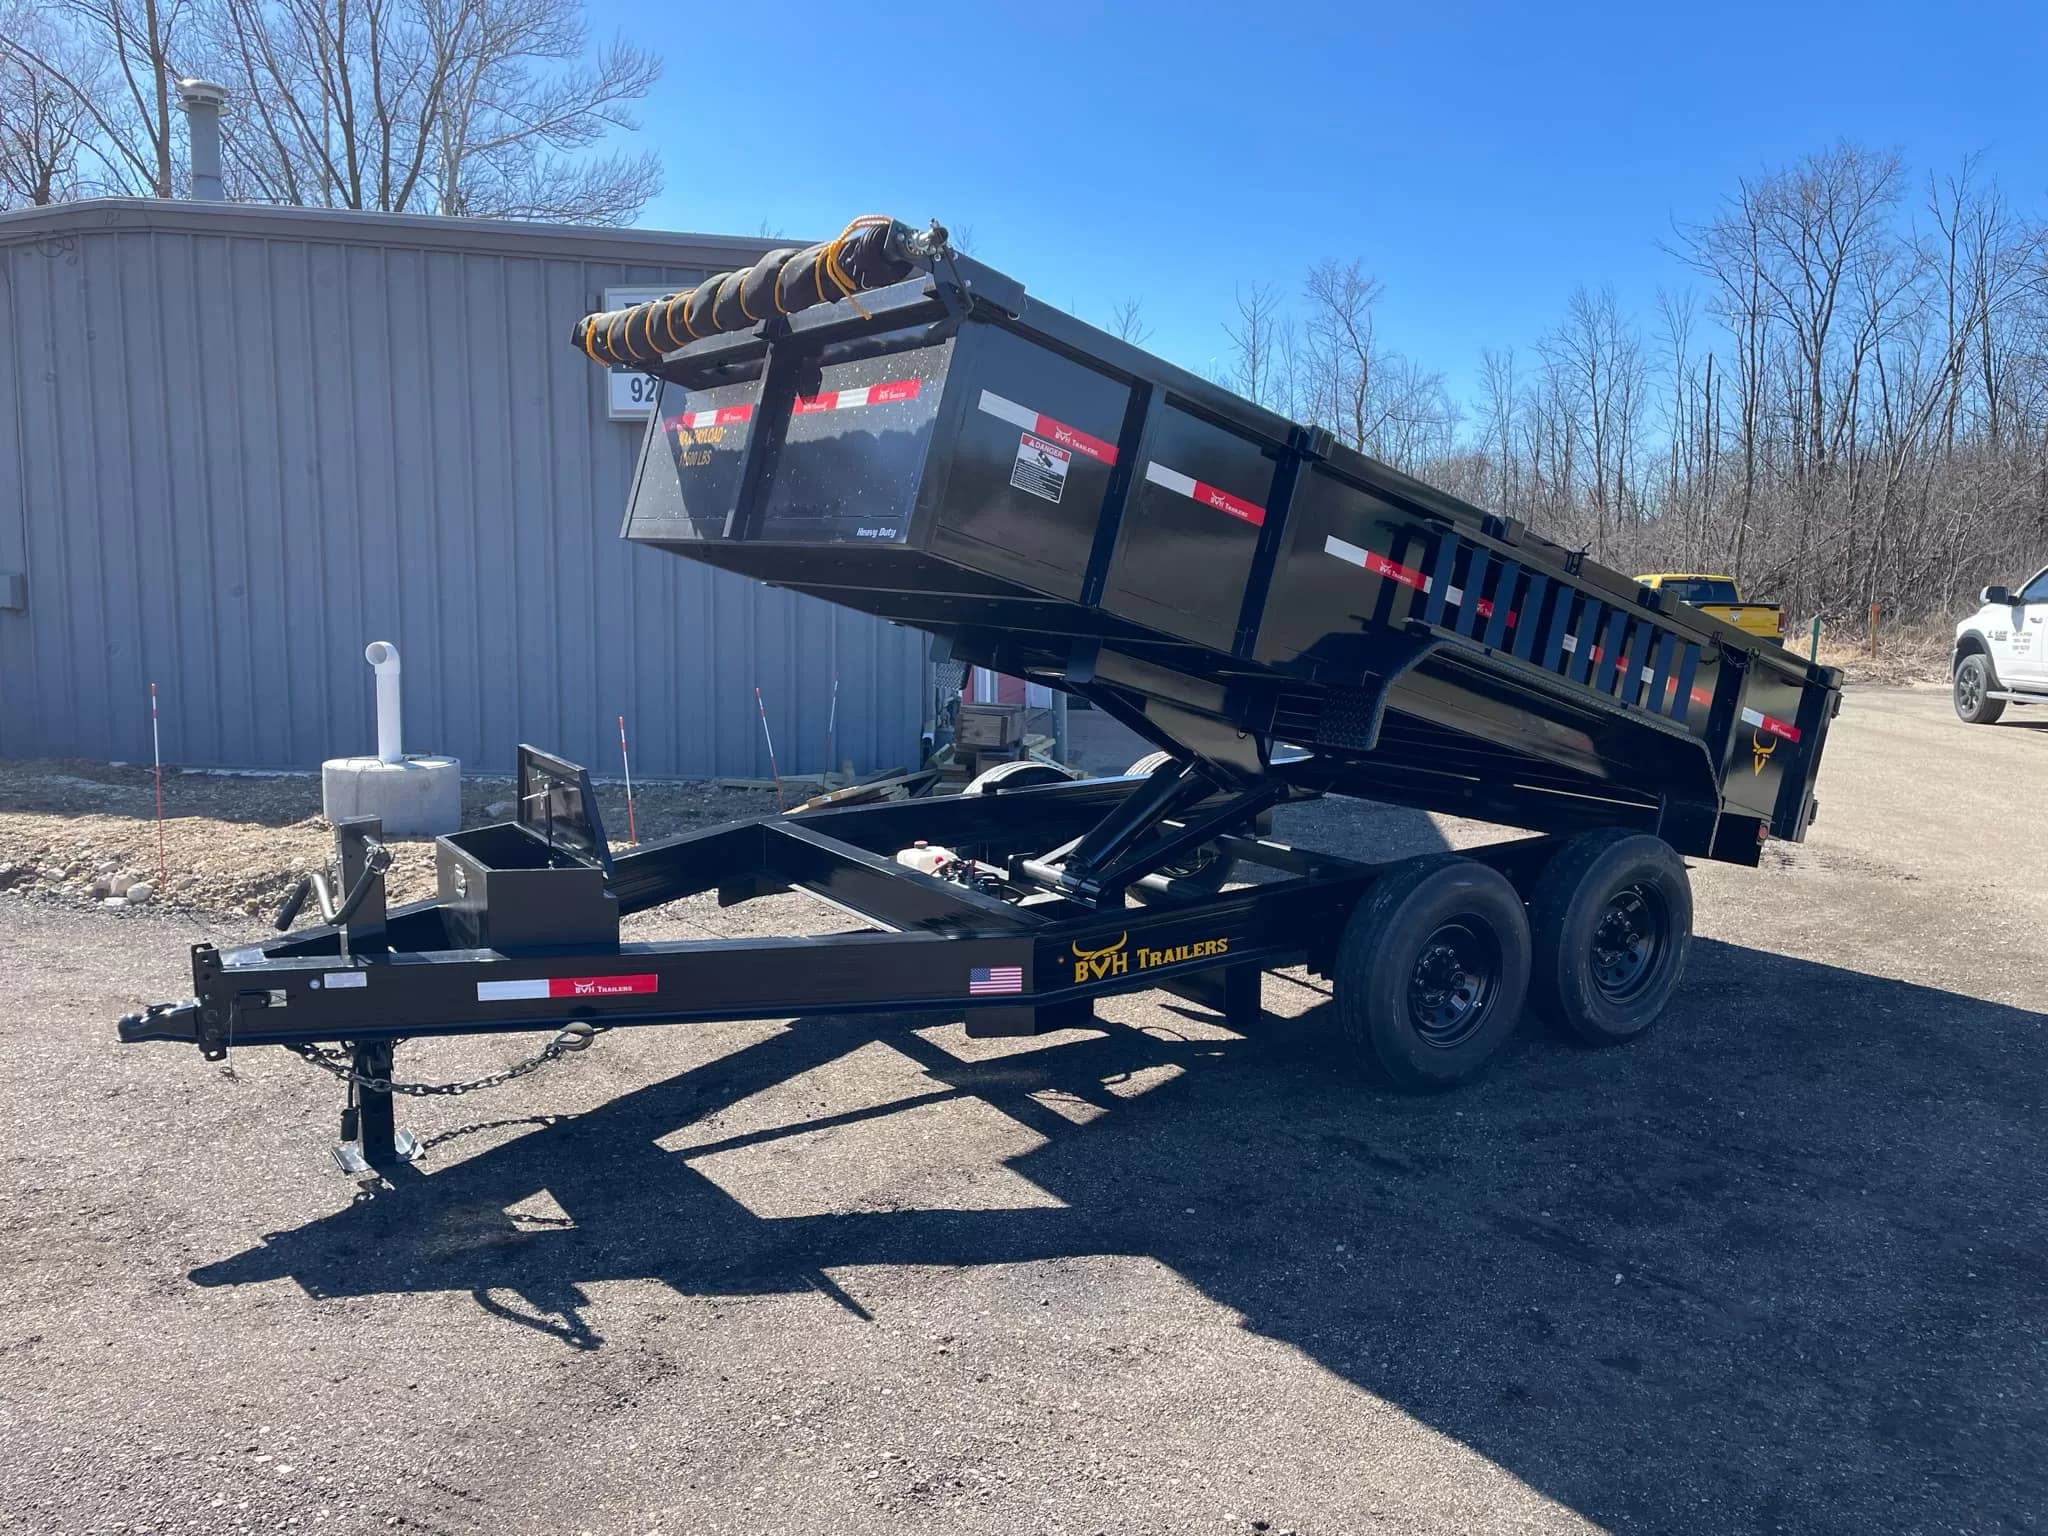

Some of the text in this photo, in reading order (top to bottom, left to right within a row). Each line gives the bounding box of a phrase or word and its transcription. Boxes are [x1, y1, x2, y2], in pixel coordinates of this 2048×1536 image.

[1035, 441, 1064, 459] DANGER
[856, 527, 897, 538] Heavy Duty
[1073, 942, 1128, 983] BVH
[575, 984, 595, 994] BVH
